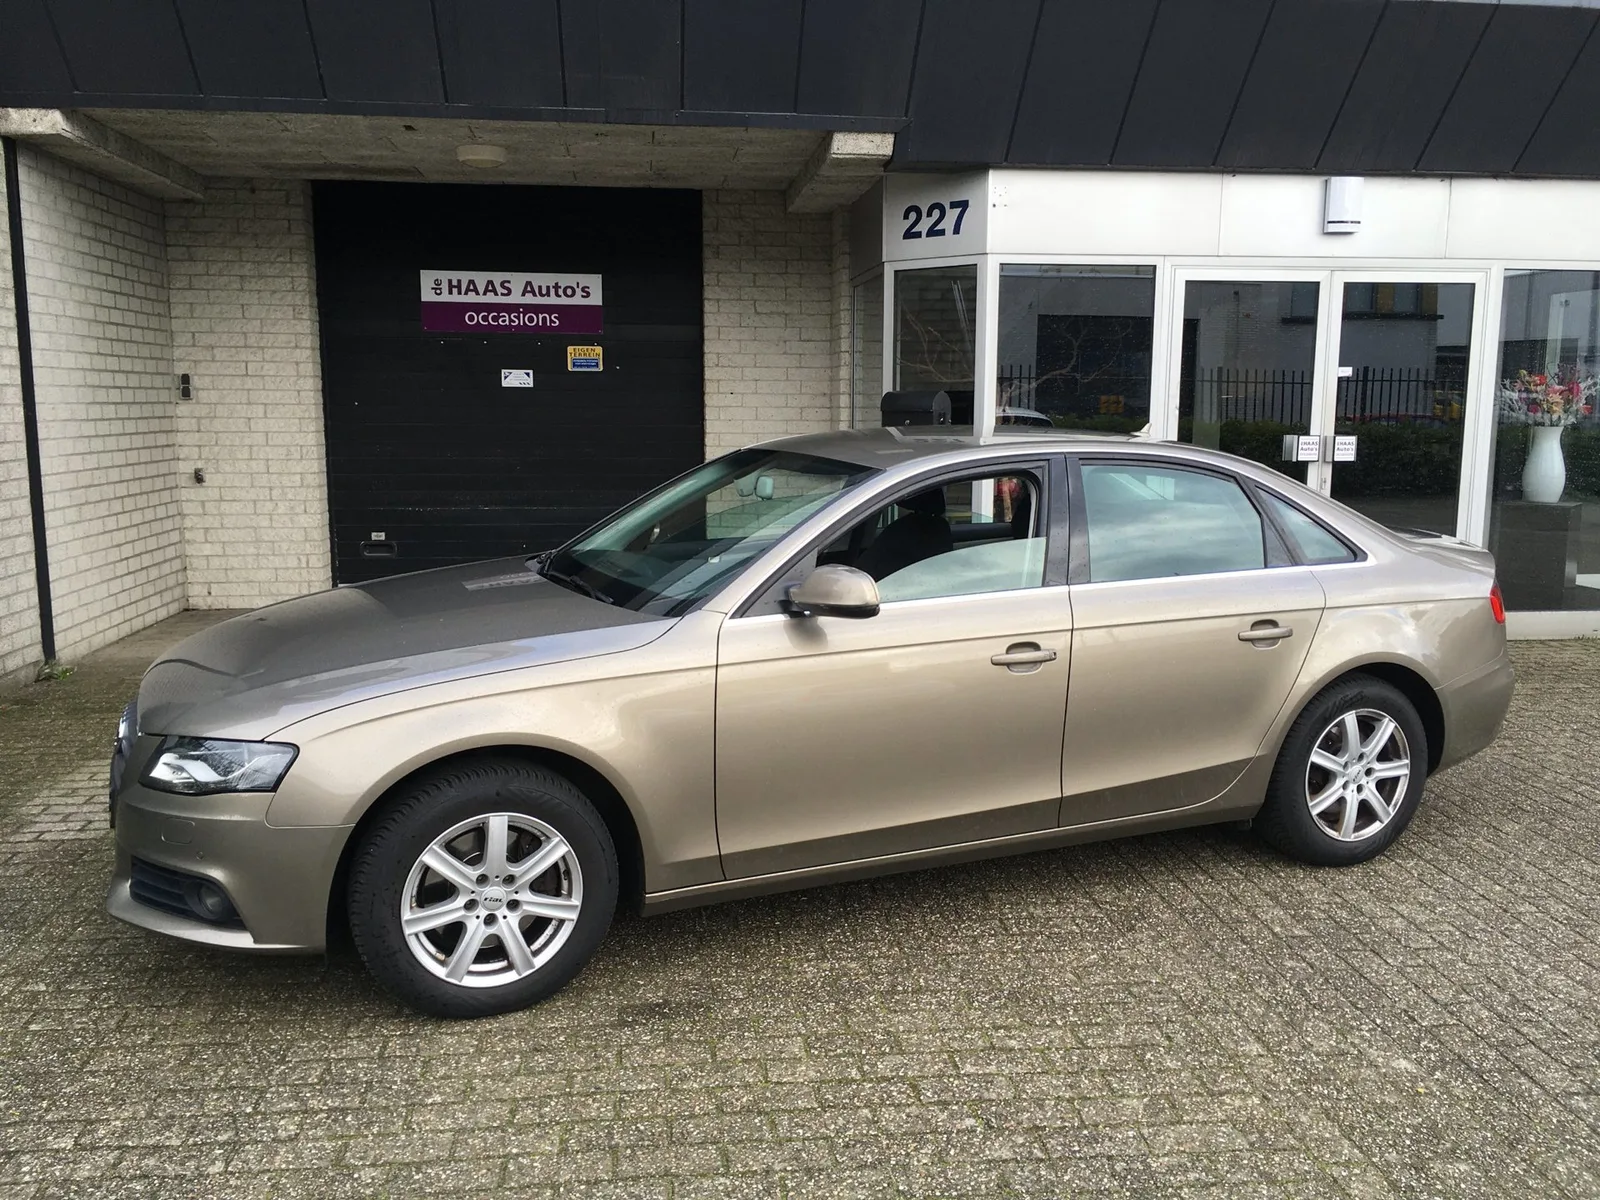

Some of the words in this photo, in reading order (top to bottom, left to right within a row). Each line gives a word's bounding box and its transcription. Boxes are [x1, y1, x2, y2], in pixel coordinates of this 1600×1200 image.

[902, 199, 969, 240] 227
[431, 278, 443, 296] de
[447, 278, 513, 297] HAAS
[520, 280, 591, 299] Auto's
[464, 308, 560, 327] occasions
